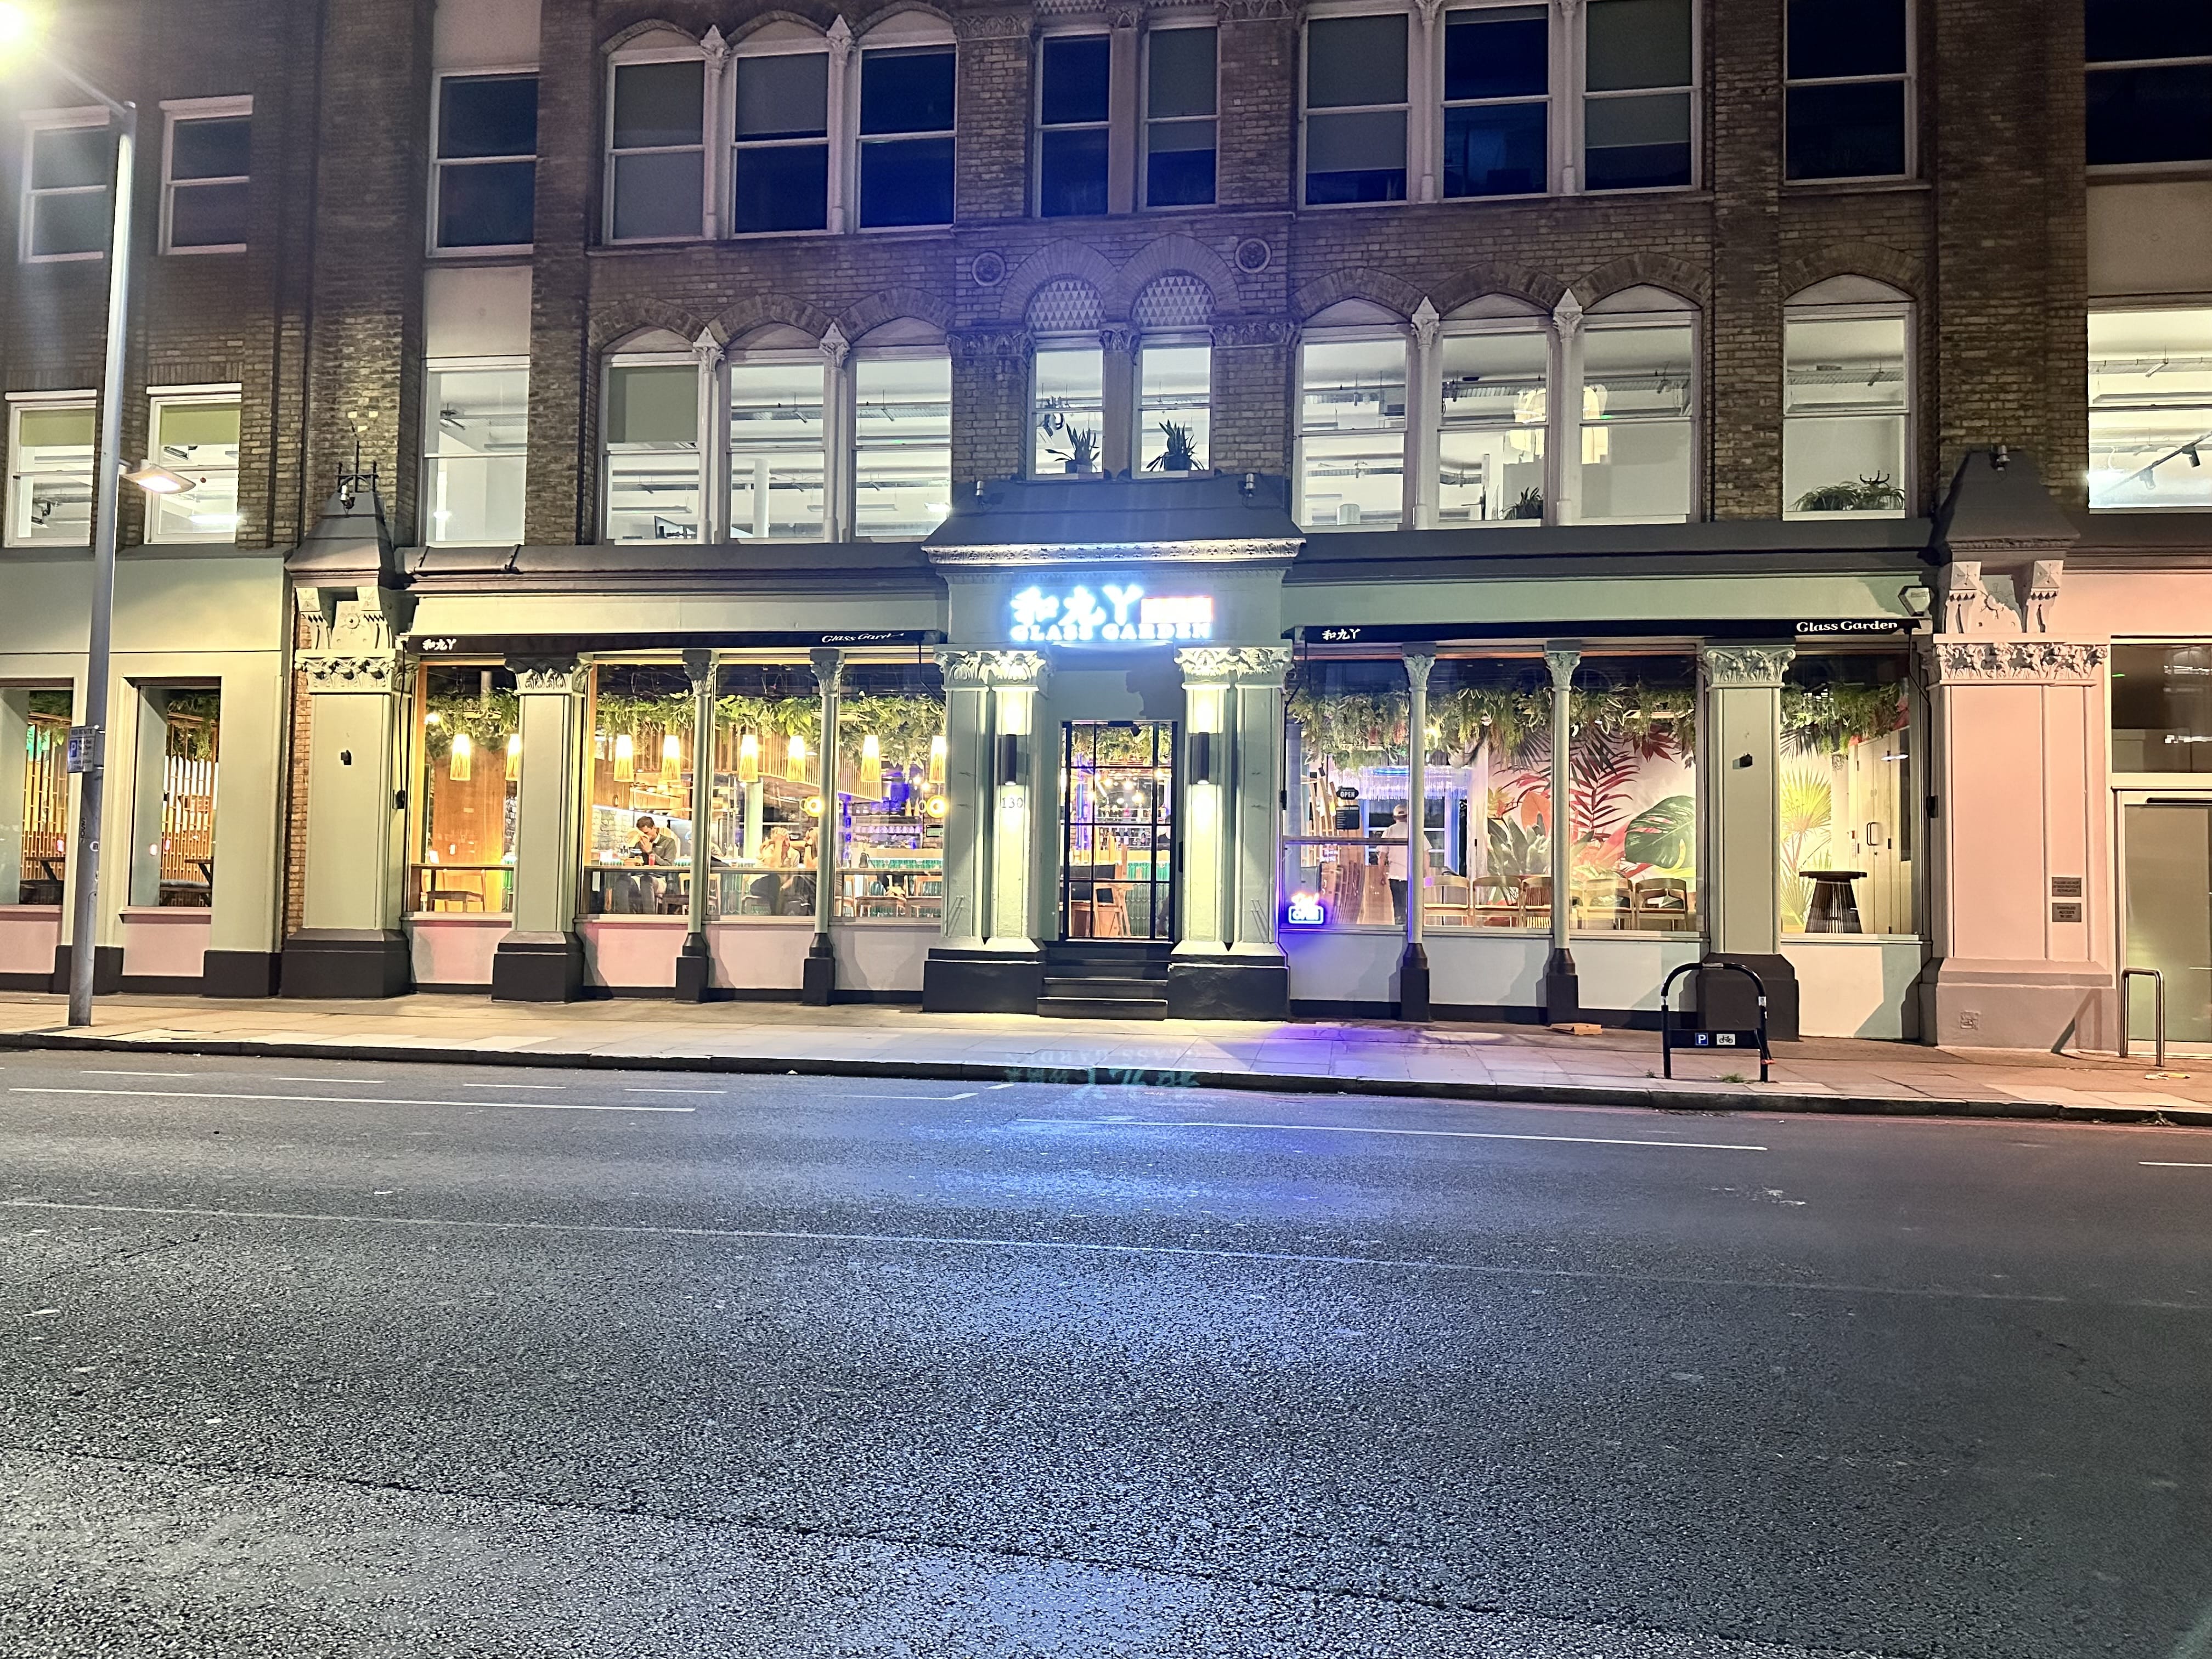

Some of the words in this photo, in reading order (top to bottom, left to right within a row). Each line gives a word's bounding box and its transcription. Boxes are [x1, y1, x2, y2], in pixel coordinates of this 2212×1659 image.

[1796, 622, 1838, 632] Glass
[1840, 620, 1898, 630] Garden
[1011, 624, 1093, 641] GLASS
[1101, 623, 1211, 639] GARDEN
[1002, 797, 1023, 808] 130
[1698, 1034, 1706, 1044] P
